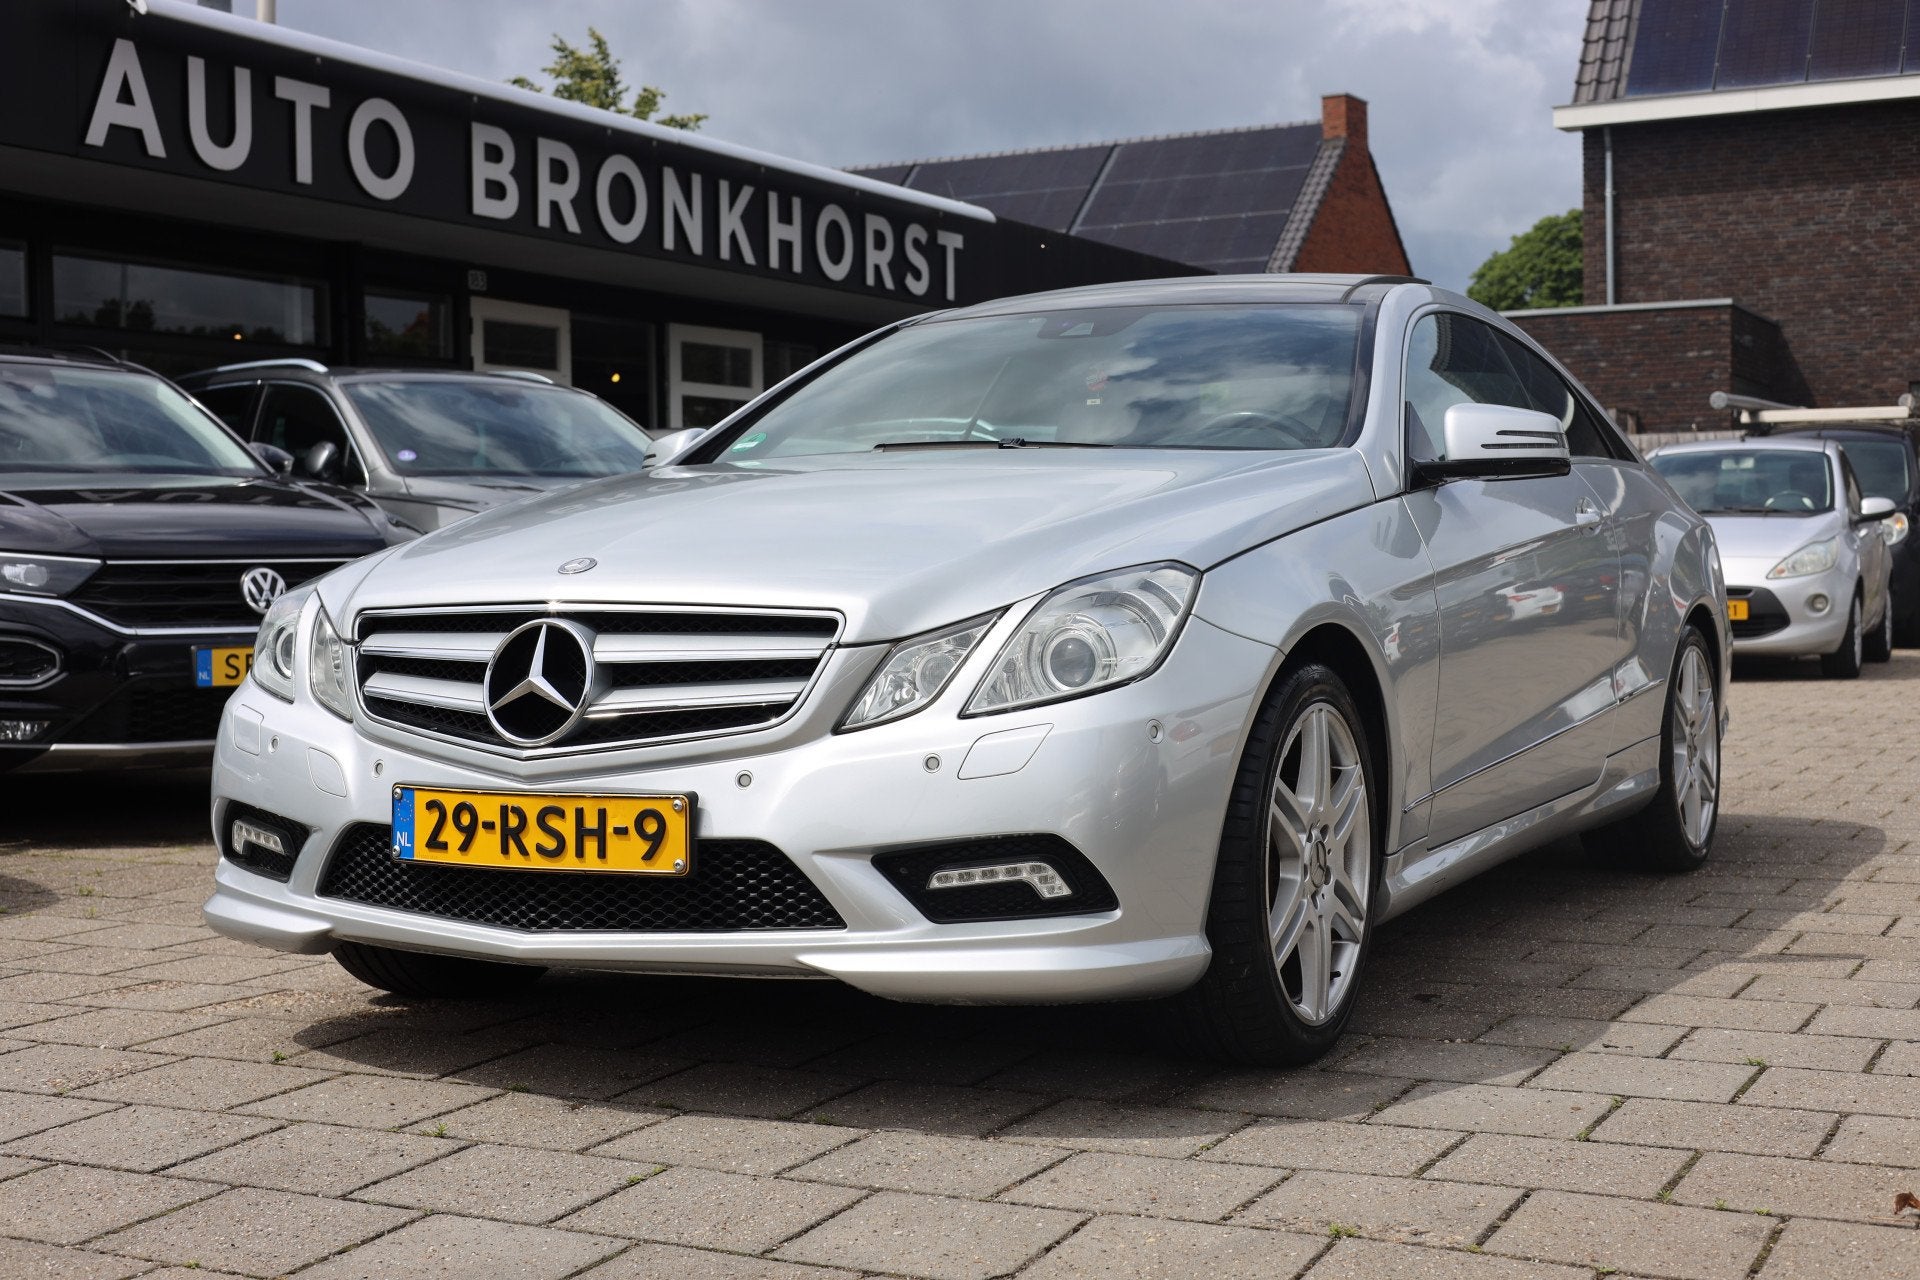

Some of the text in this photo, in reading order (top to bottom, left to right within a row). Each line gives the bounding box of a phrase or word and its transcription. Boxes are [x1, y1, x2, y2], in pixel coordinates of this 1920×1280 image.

[85, 38, 965, 301] AUTO BRONKHORST
[198, 671, 210, 680] NL
[396, 799, 666, 860] NL 29-RSH-9
